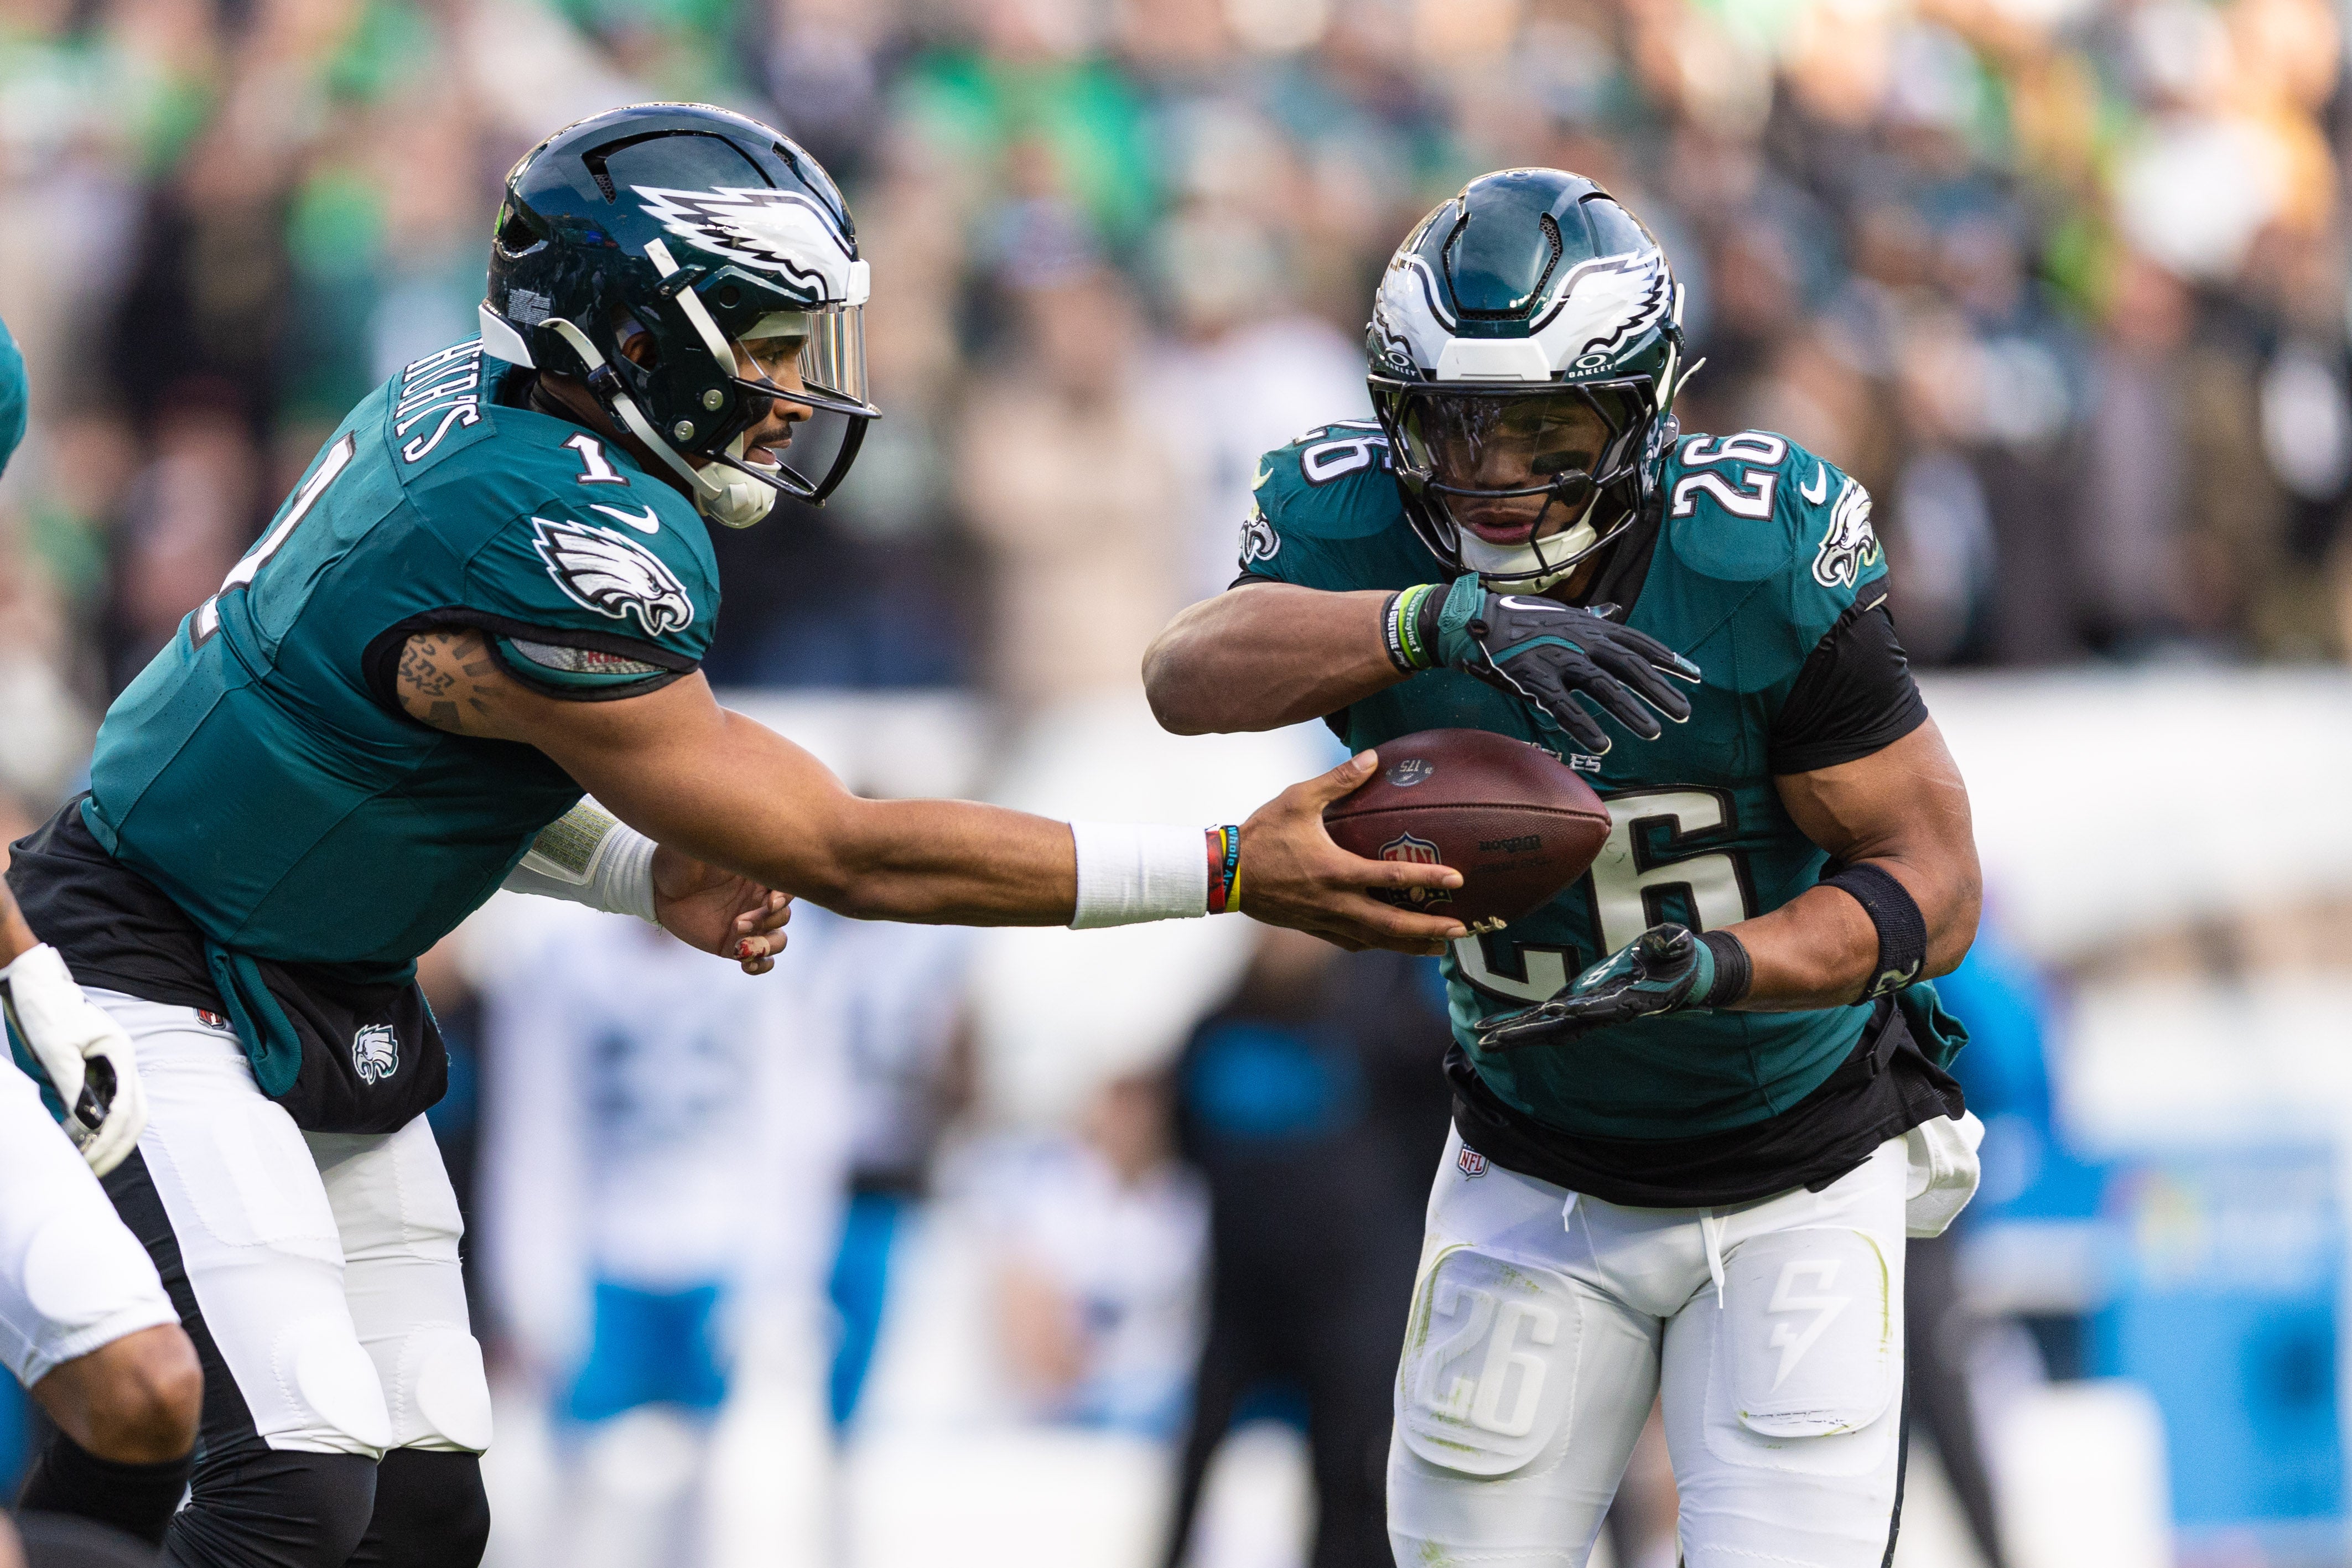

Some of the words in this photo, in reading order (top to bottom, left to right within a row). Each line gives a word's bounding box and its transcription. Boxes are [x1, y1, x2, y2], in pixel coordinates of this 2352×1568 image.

[1385, 361, 1416, 376] OAKLEY
[1568, 364, 1613, 378] OAKLEY
[392, 336, 484, 465] HURTS
[559, 431, 630, 487] 1
[1670, 431, 1789, 522] 26
[1388, 610, 1400, 650] CULTURE
[1227, 826, 1238, 866] Whole
[1460, 1151, 1482, 1172] NFL
[1414, 1283, 1559, 1437] 26
